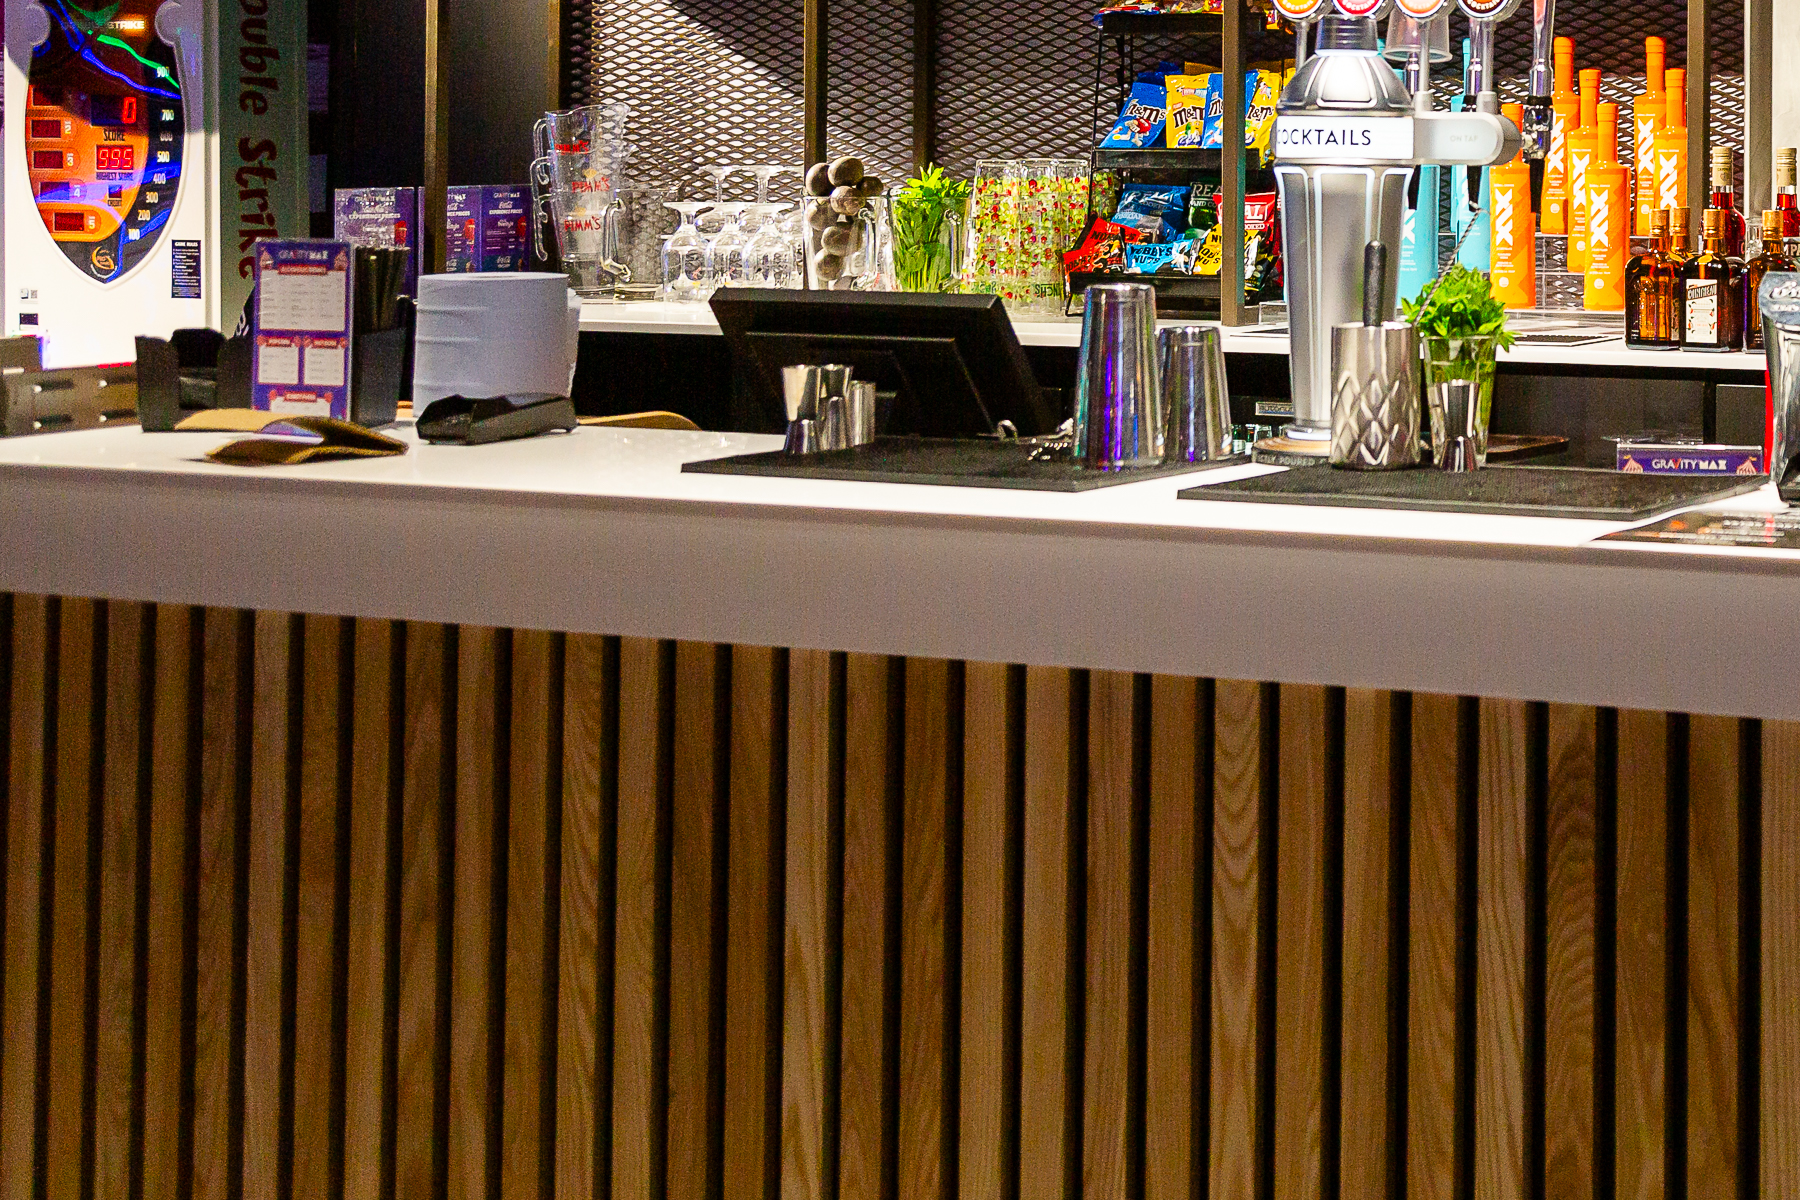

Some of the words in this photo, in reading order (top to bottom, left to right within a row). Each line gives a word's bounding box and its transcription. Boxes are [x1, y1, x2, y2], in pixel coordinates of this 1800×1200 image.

[1192, 184, 1222, 198] REA
[235, 137, 279, 281] Strike
[1279, 456, 1316, 466] POURED
